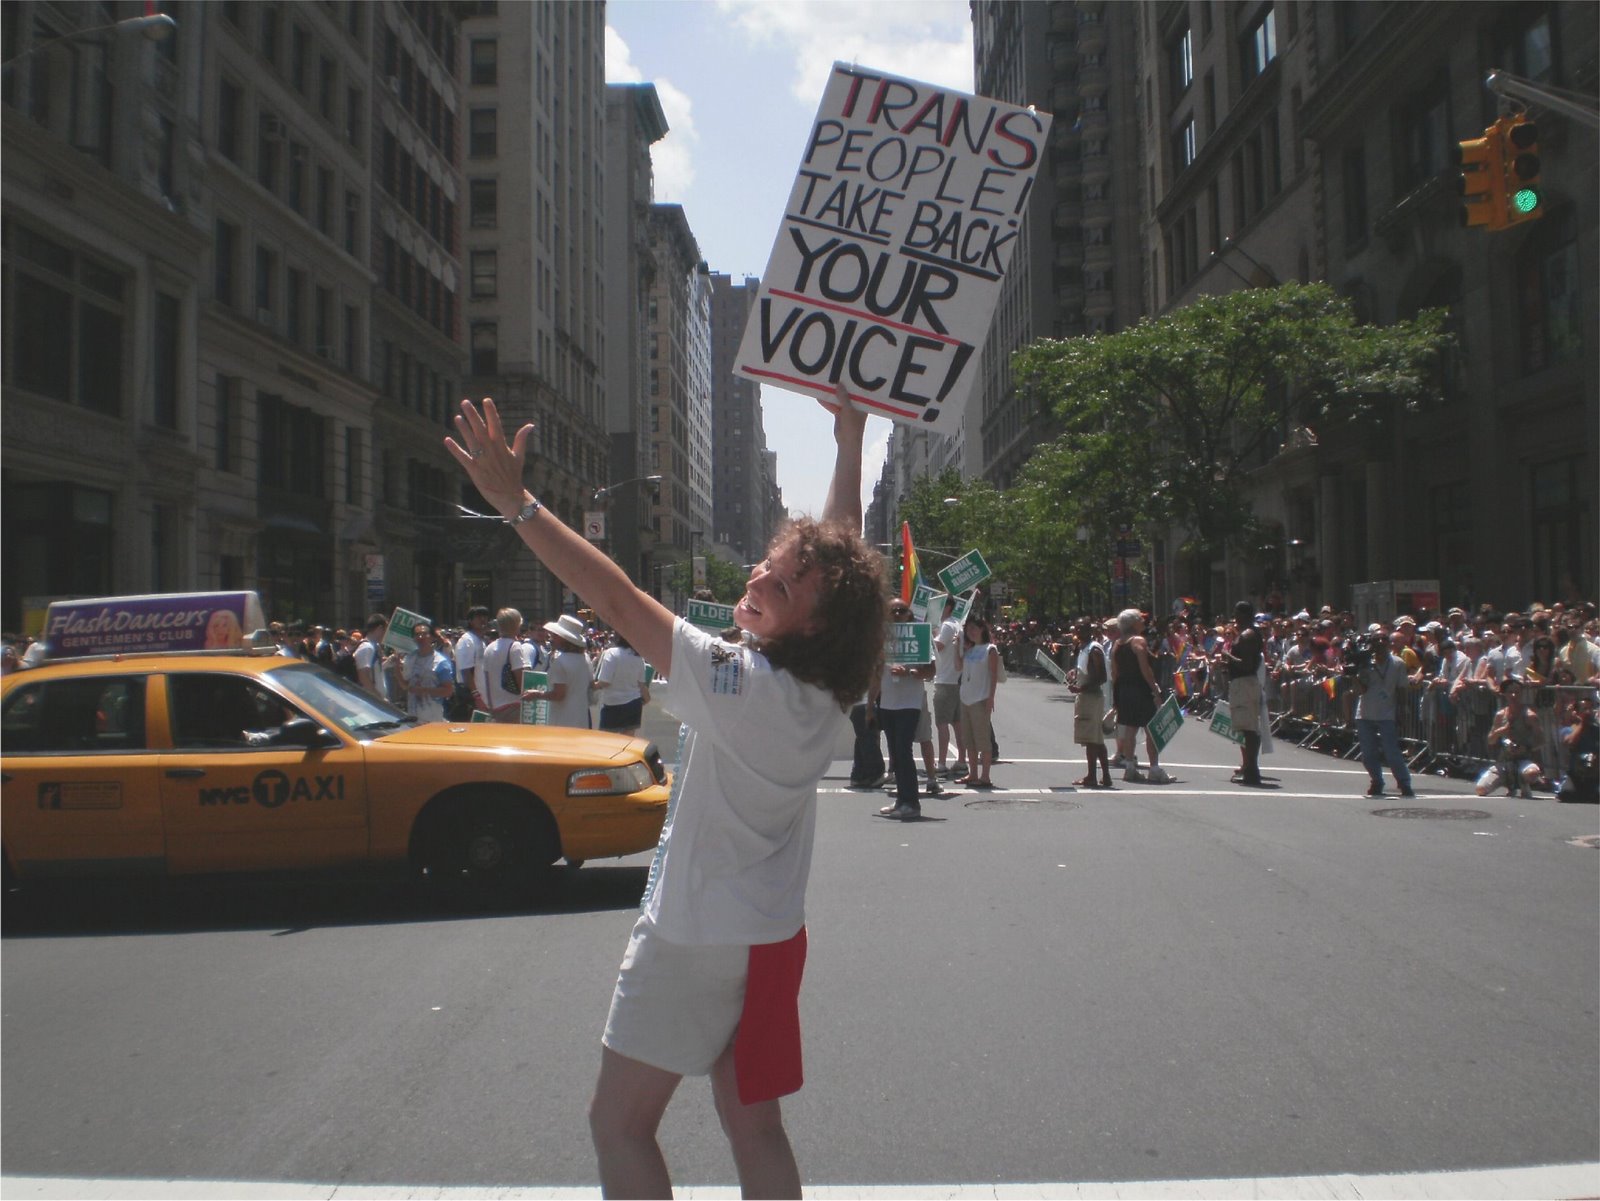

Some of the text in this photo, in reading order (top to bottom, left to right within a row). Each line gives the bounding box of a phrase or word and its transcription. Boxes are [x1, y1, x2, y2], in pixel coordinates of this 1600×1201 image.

[835, 67, 1043, 170] TRANS
[804, 119, 1034, 228] PEOPLE!
[800, 169, 1018, 276] TAKE BACK
[789, 227, 959, 336] YOUR
[760, 298, 975, 423] VOICE!
[948, 557, 973, 577] EQUAL
[951, 564, 980, 588] RIGHTS
[49, 607, 209, 635] FlashDancers
[690, 603, 735, 621] TLDEF
[62, 632, 155, 648] GENTLEMEN'S
[159, 629, 194, 641] CLUB
[198, 770, 345, 807] NYC TAXI
